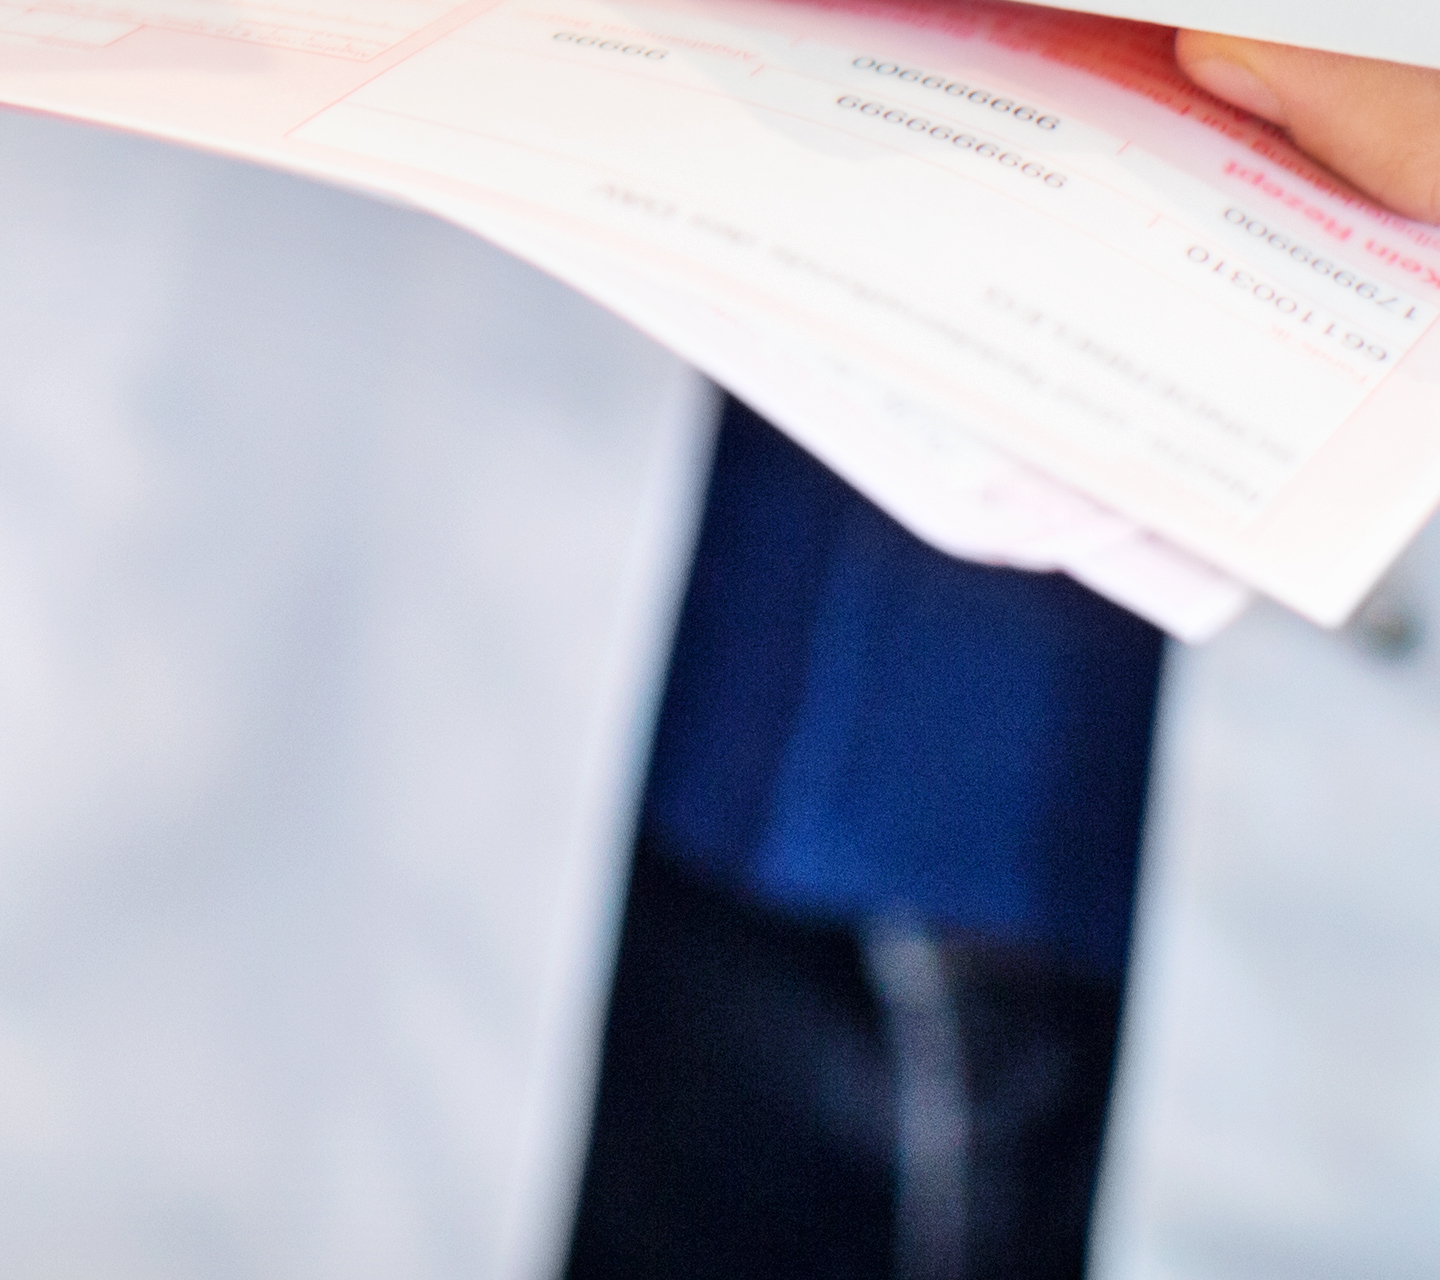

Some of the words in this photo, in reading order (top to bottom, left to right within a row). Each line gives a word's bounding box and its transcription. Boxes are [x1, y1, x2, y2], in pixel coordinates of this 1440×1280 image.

[1221, 157, 1354, 242] Rezept
[1184, 243, 1390, 365] 661100310
[1222, 206, 1419, 323] 179999900
